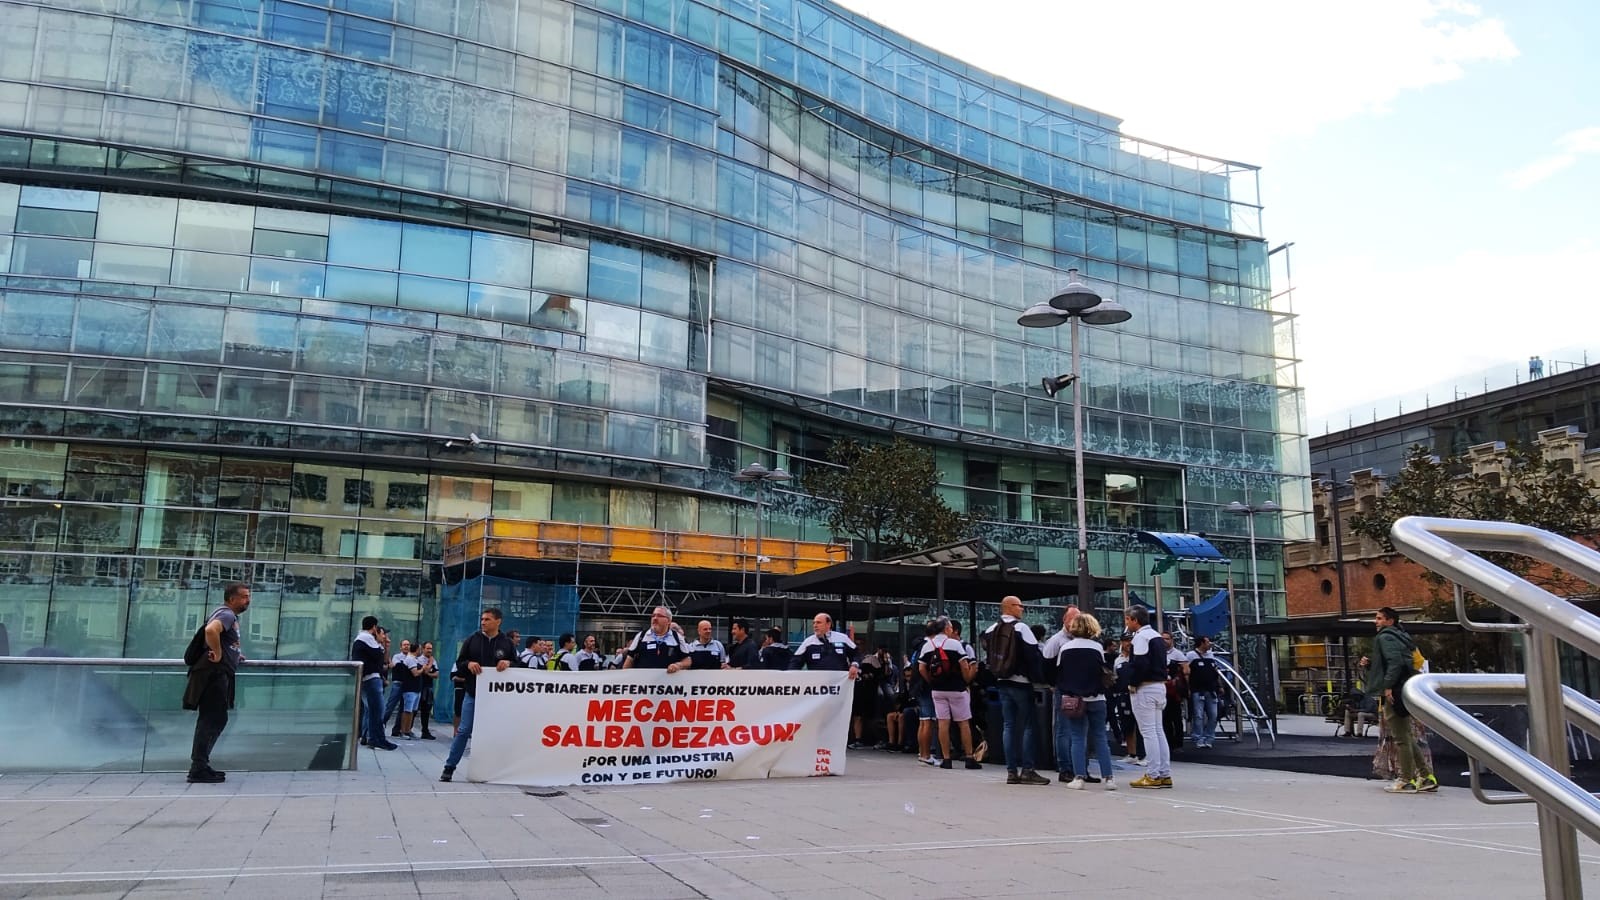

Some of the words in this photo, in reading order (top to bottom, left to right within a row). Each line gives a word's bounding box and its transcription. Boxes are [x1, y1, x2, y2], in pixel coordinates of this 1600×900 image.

[488, 682, 599, 694] INDUSTRIAREN
[602, 684, 688, 697] DEFENTSAN,
[690, 685, 801, 696] ETORKIZUNAREN
[803, 685, 841, 696] ALDE!
[587, 699, 736, 722] MECANER
[541, 725, 645, 748] SALBA
[582, 756, 618, 768] ¡POR
[621, 755, 652, 766] UNA
[655, 752, 735, 765] INDUSTRIA
[581, 772, 613, 783] CON
[617, 772, 629, 781] Y
[632, 771, 652, 780] DE
[656, 768, 718, 778] FUTURO!
